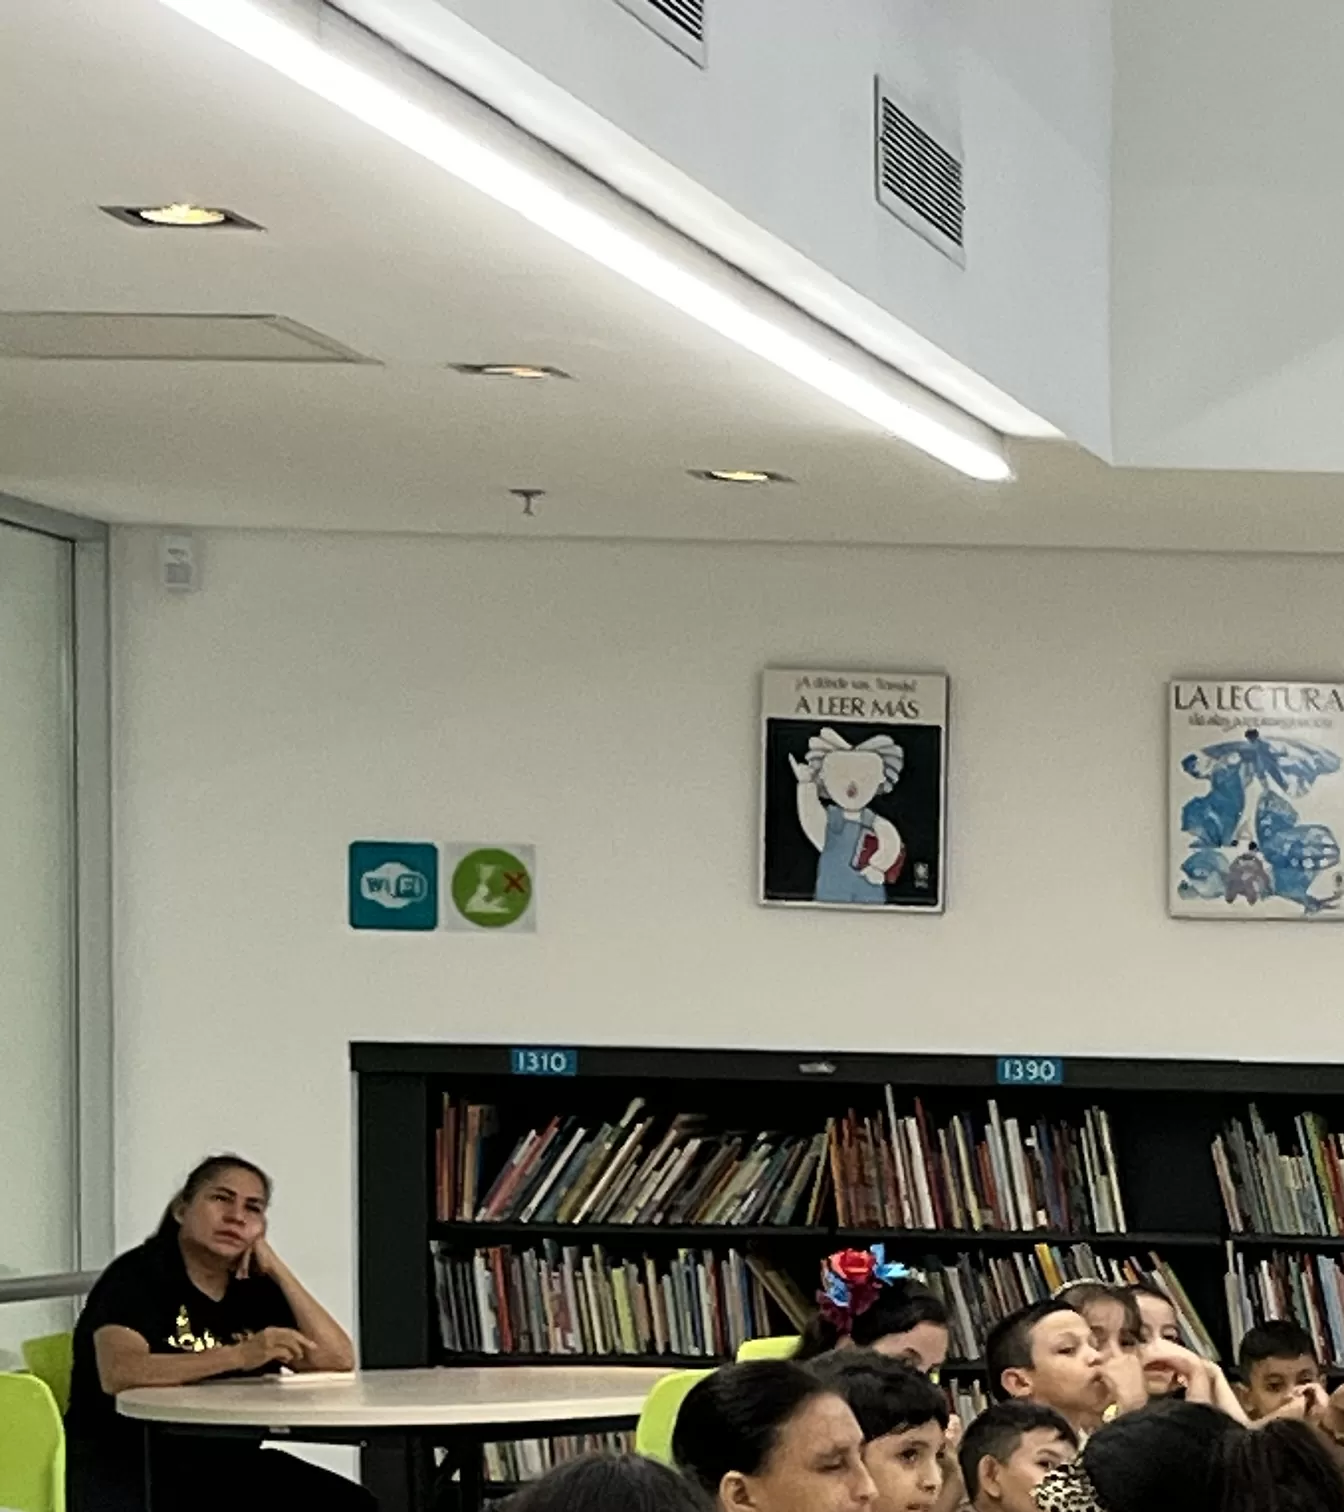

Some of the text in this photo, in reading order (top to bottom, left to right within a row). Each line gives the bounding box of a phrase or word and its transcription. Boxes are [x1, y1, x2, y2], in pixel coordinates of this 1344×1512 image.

[795, 694, 919, 719] A LEER MÁS
[1174, 684, 1344, 713] LA LECTURA
[518, 1051, 567, 1073] 1310
[1004, 1059, 1055, 1081] 1390
